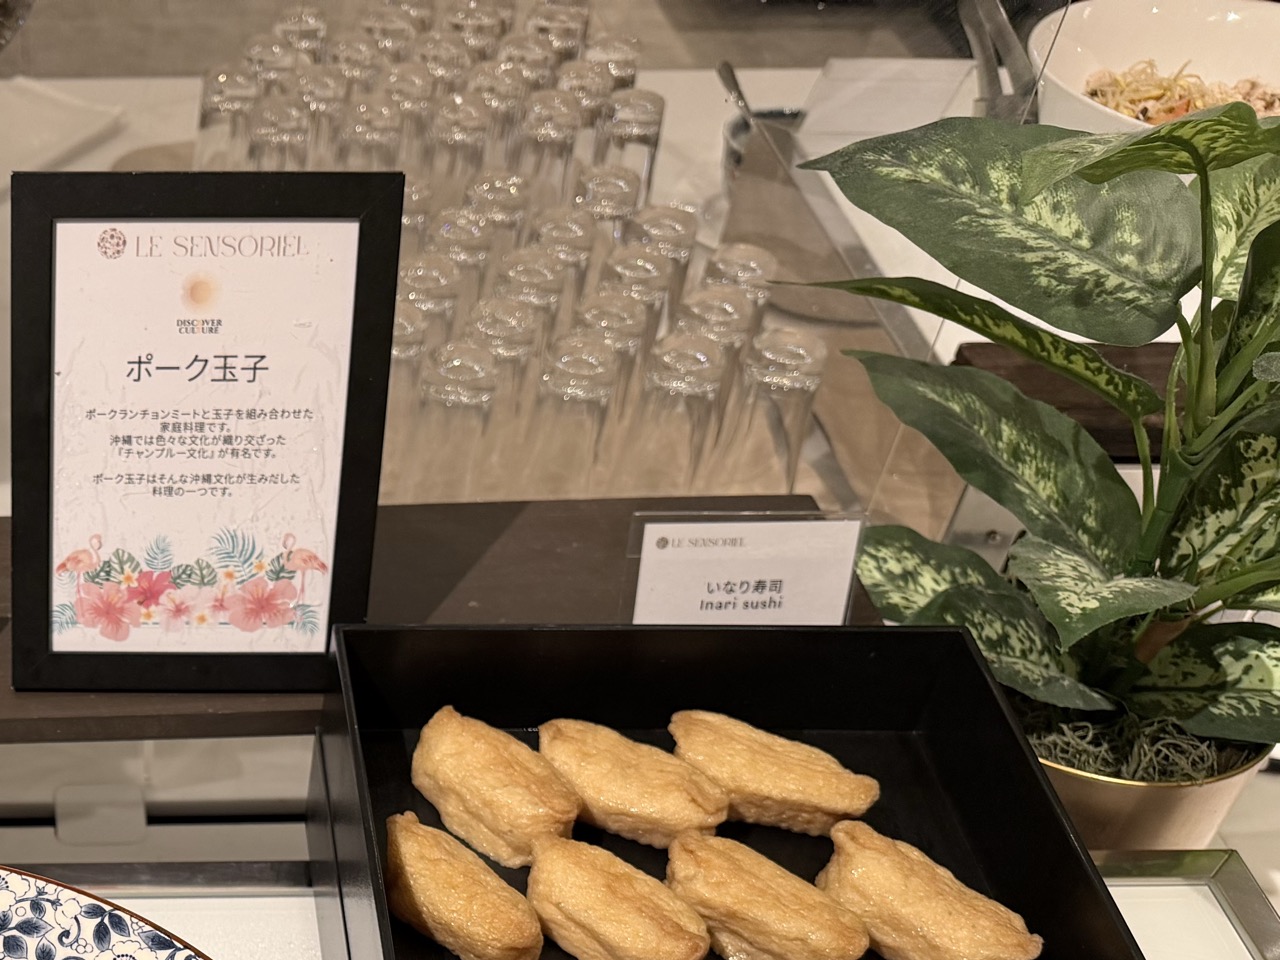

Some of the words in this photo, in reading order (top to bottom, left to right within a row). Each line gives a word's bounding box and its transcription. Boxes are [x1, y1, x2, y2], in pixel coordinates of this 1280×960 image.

[135, 235, 164, 258] LE
[172, 234, 310, 258] SENSORIEL
[176, 319, 223, 327] DISCOVER
[126, 353, 270, 383] ポーク玉子
[85, 408, 314, 421] ポークランチョンミートと玉子を組み合わせた
[159, 422, 232, 434] 家庭料理です。
[109, 434, 287, 447] 沖縄では色々な文化が織り交ざった
[92, 473, 301, 486] ポーク玉子はそんな沖縄文化が生みだした
[152, 486, 233, 498] 料理の一つです。
[706, 579, 784, 595] いなり寿司
[699, 596, 738, 611] Inari
[742, 595, 784, 610] sushi
